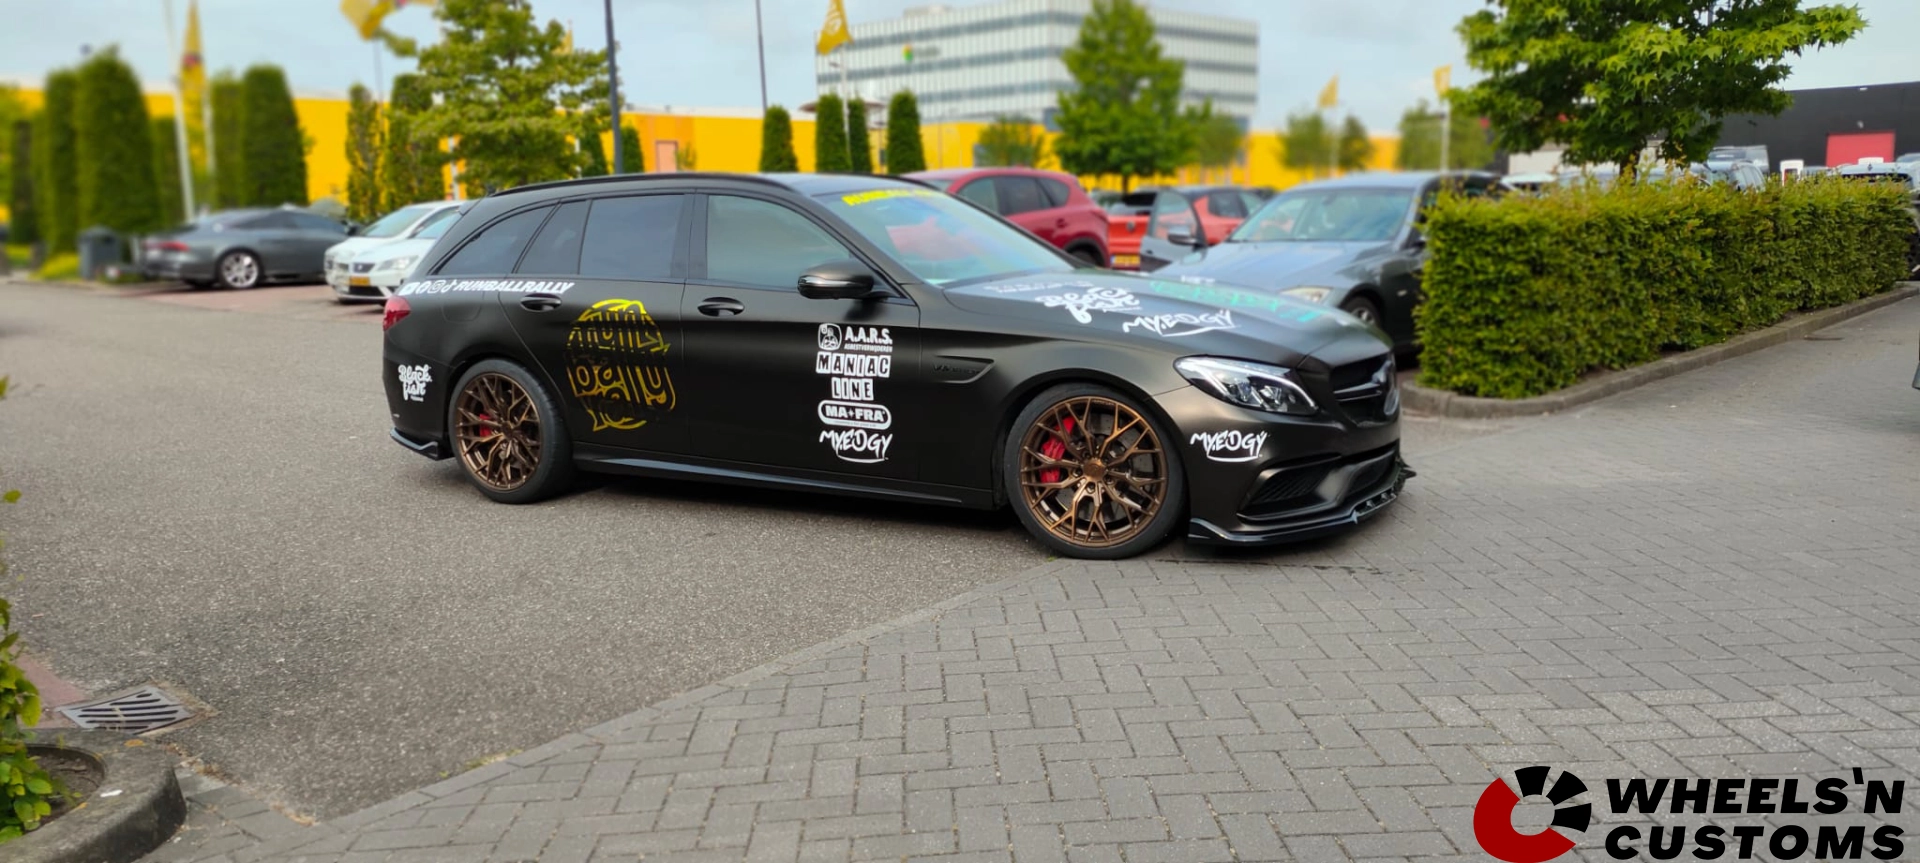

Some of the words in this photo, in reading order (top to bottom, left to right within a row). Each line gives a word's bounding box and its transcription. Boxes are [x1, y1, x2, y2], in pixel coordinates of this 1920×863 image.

[844, 326, 893, 345] A.A.R.S.
[817, 352, 890, 377] MANIAC
[831, 378, 873, 400] LINE
